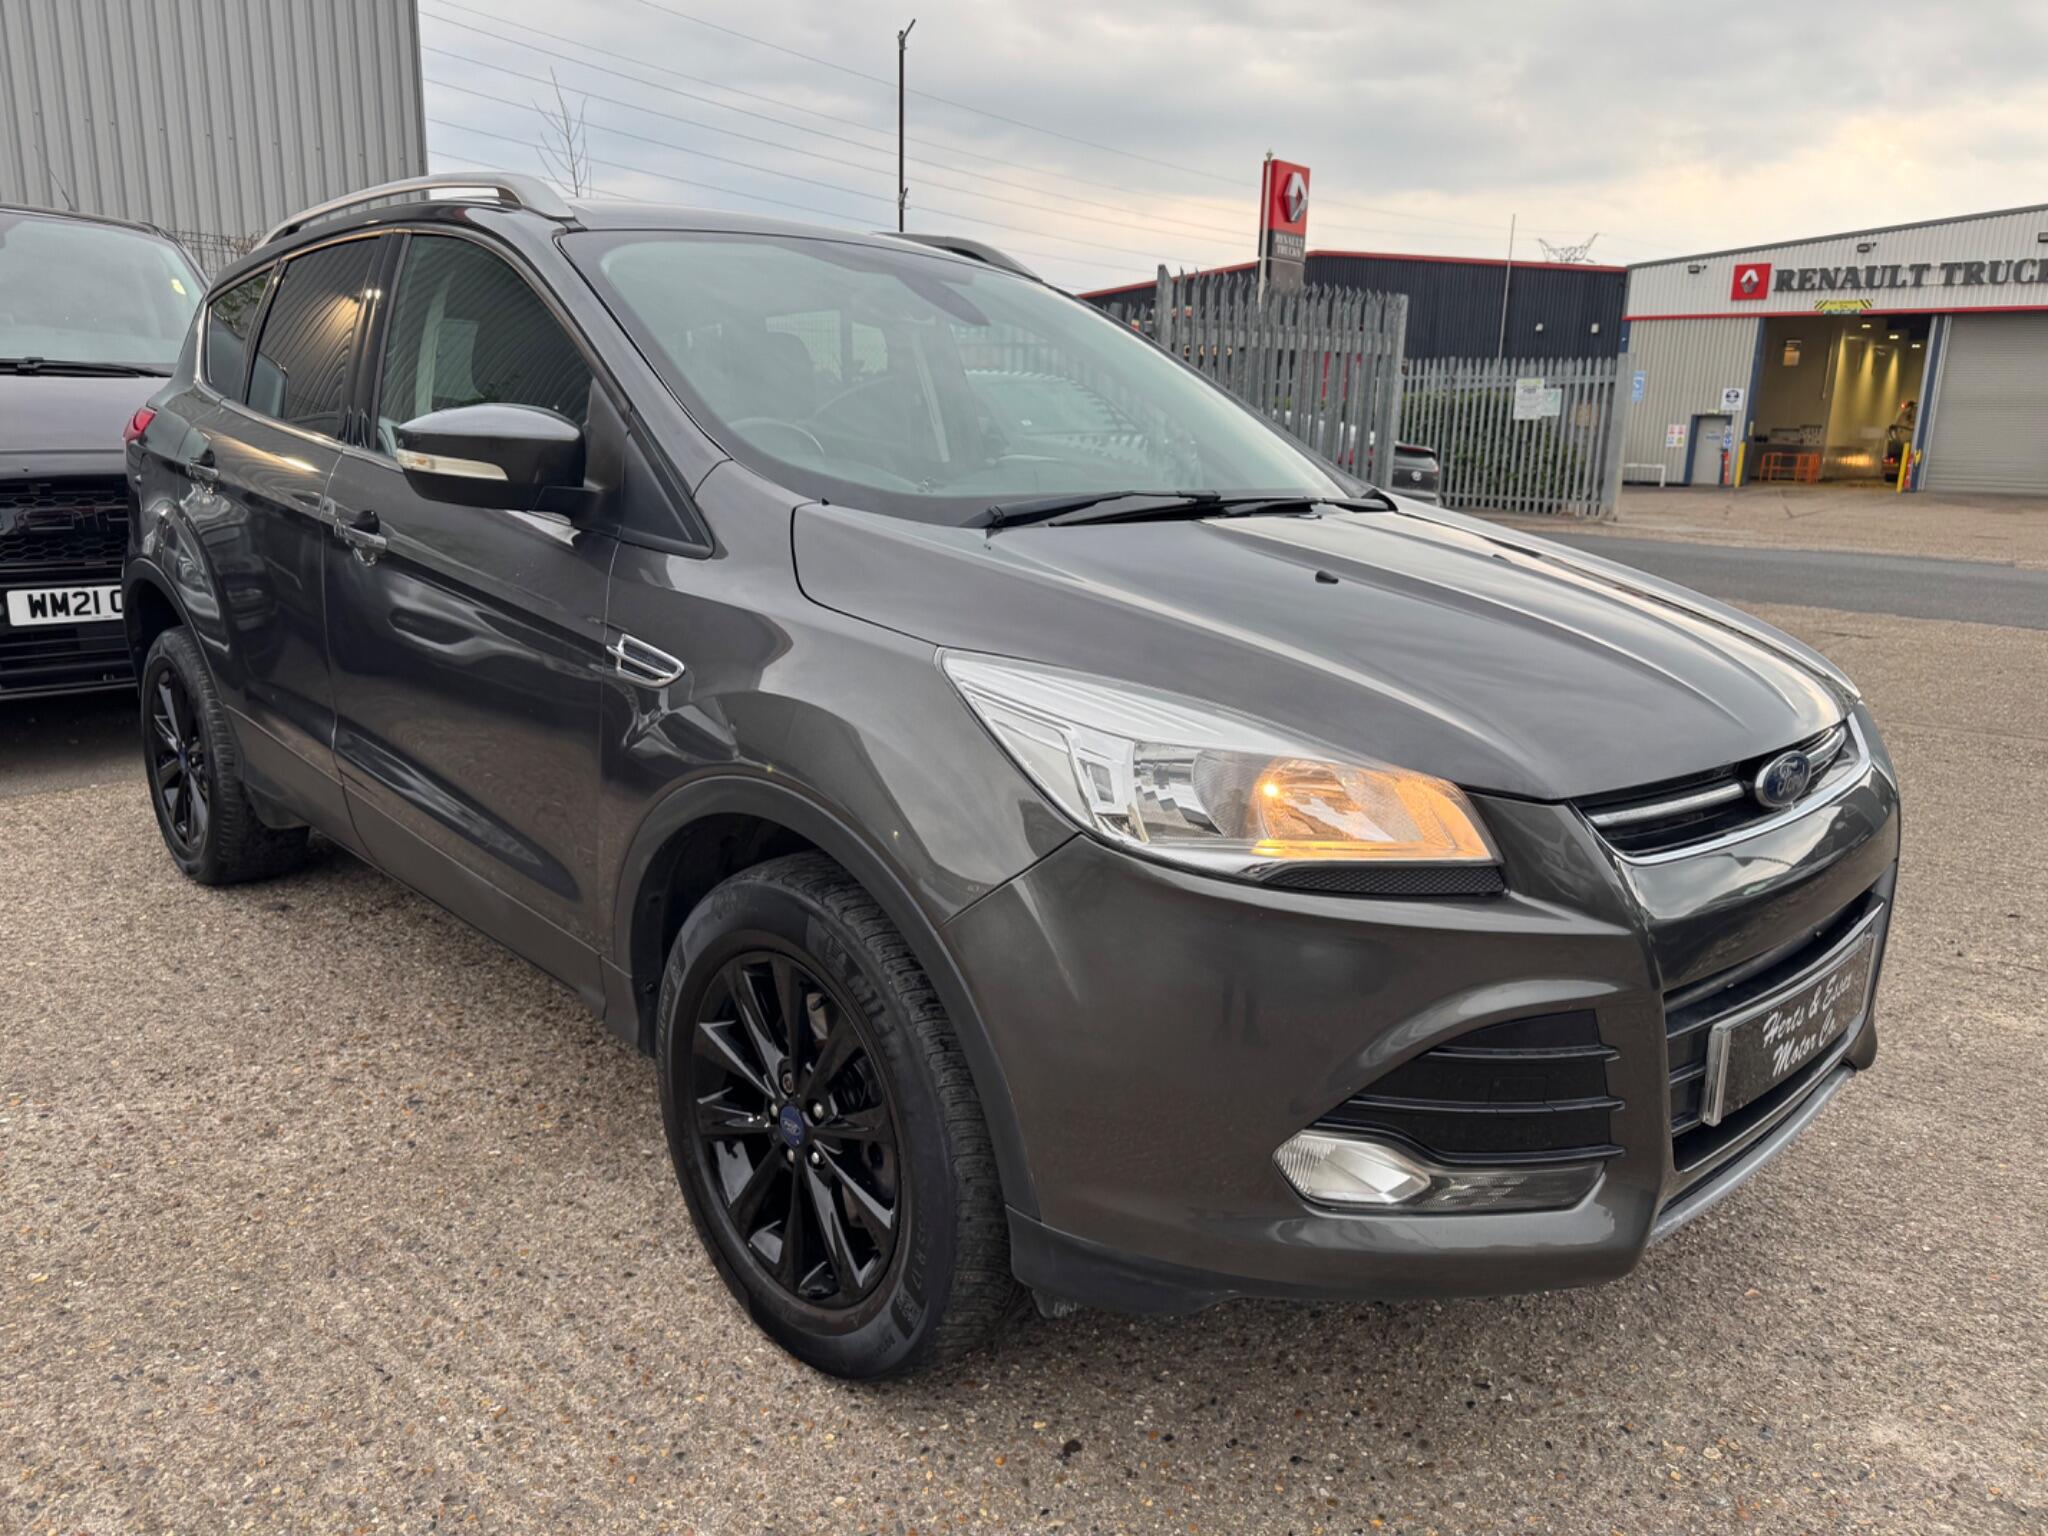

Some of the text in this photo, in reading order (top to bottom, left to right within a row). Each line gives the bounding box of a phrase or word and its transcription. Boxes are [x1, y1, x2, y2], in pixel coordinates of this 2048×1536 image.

[1773, 264, 1931, 293] RENAULT
[27, 590, 101, 619] WM21
[1772, 1036, 1817, 1077] Motor
